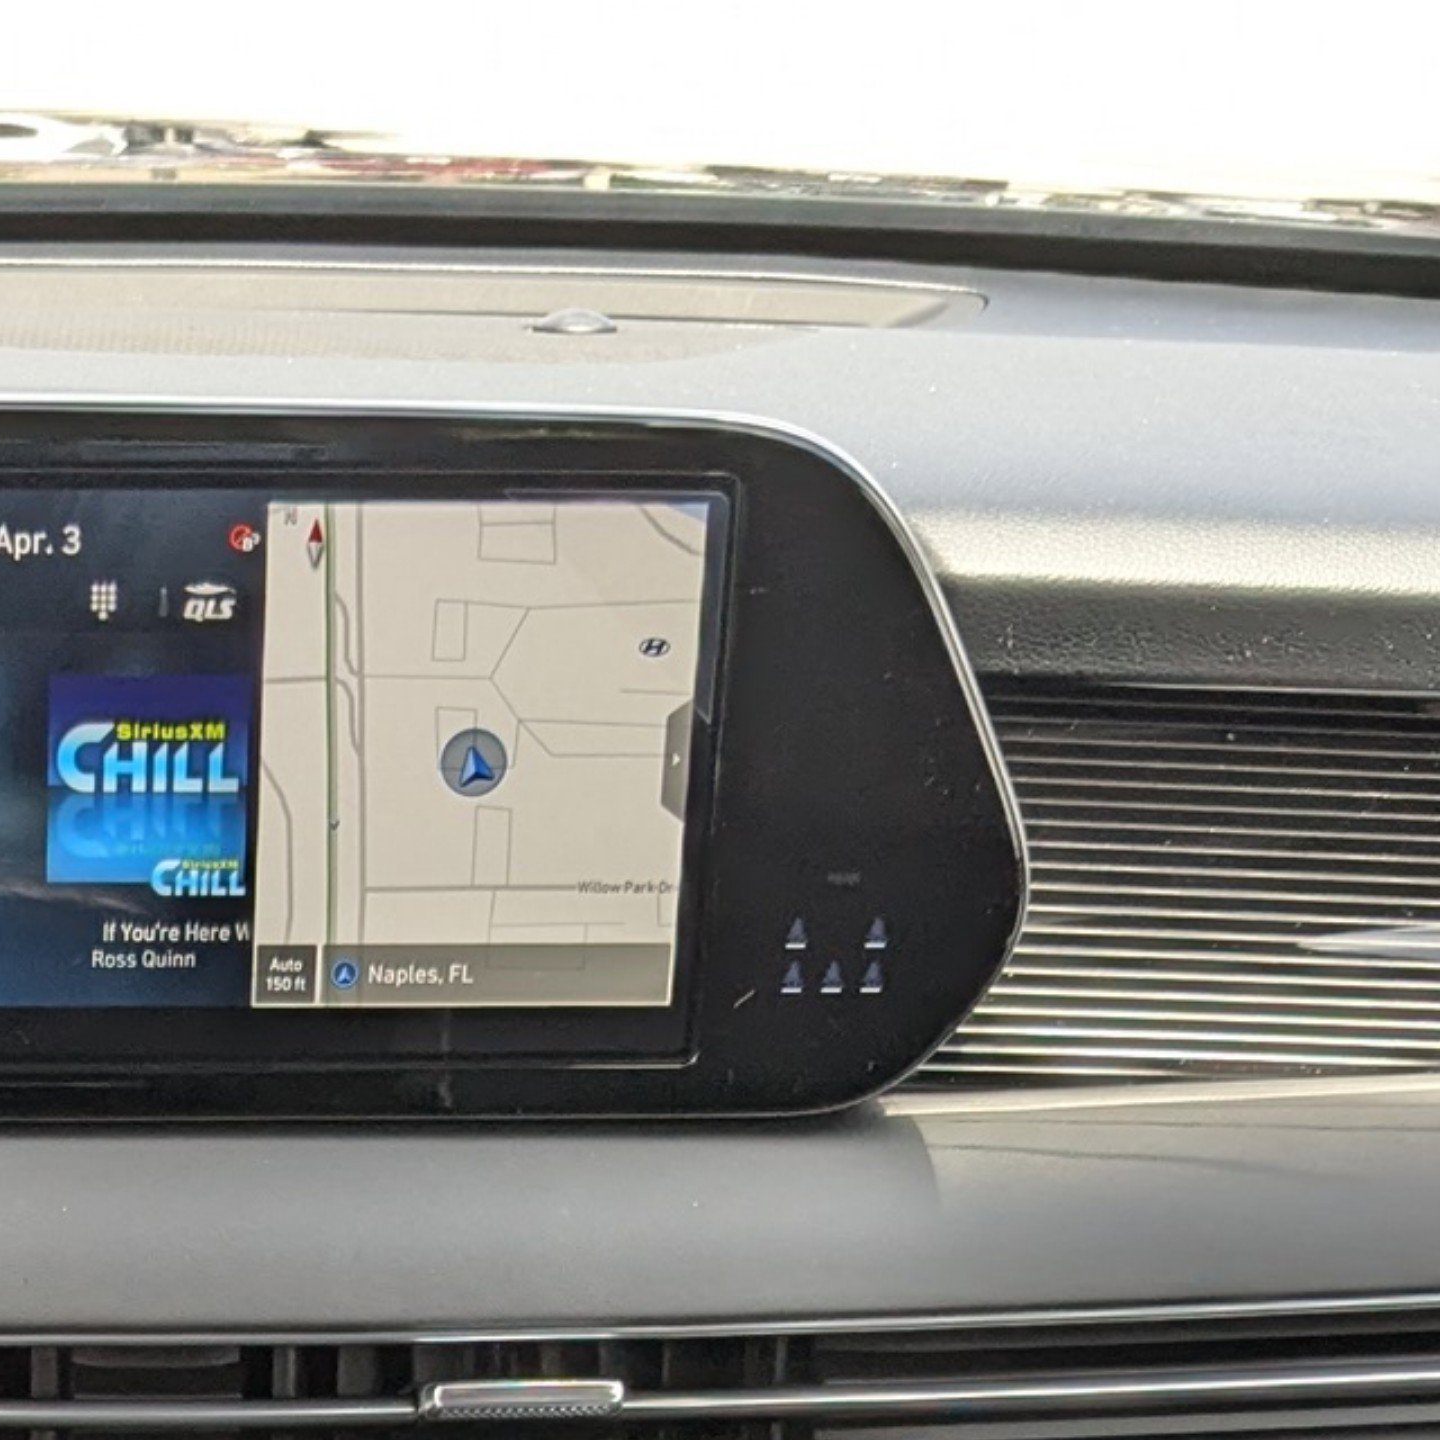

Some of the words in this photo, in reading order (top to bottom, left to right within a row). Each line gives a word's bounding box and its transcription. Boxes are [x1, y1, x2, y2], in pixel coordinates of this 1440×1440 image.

[61, 524, 82, 556] 3
[115, 721, 227, 741] SiriusXM
[57, 723, 239, 793] CHILL
[151, 859, 247, 896] CHILL
[577, 880, 621, 895] Willow
[624, 880, 655, 895] Park
[103, 921, 115, 942] If
[121, 921, 180, 942] You're
[185, 921, 230, 942] Here
[92, 950, 137, 969] Ross
[141, 950, 197, 970] Quinn
[269, 956, 303, 972] Auto
[265, 977, 291, 992] 150
[293, 976, 307, 992] ft
[368, 963, 443, 988] Naples,
[449, 964, 474, 984] FL
